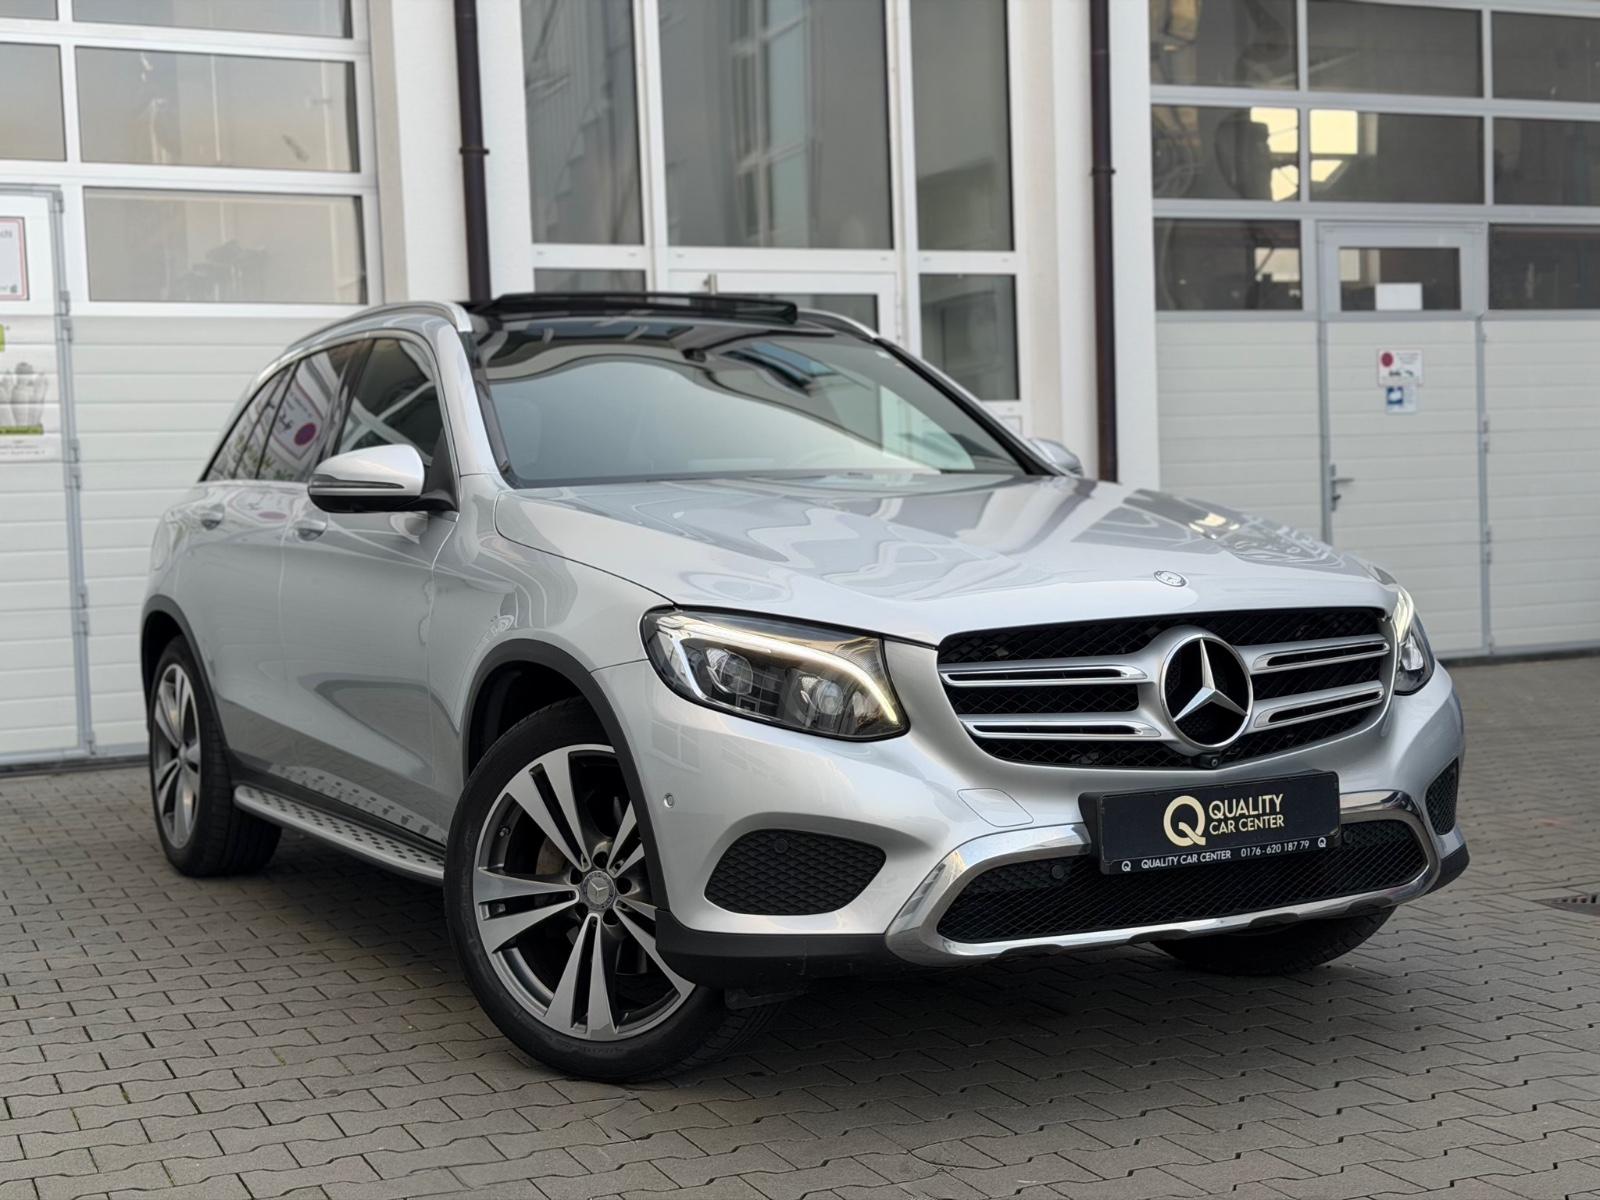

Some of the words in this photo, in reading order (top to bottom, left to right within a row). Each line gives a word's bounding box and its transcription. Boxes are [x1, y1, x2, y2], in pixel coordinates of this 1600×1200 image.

[1163, 795, 1206, 847] Q
[1208, 793, 1284, 819] QUALITY
[1209, 820, 1236, 835] CAR
[1238, 814, 1285, 832] CENTER
[1121, 860, 1132, 872] Q
[1141, 856, 1179, 869] QUALITY
[1180, 854, 1198, 865] CAR
[1200, 850, 1231, 862] CENTER
[1283, 841, 1298, 852] 187
[1299, 840, 1310, 850] 79
[1317, 837, 1327, 848] Q
